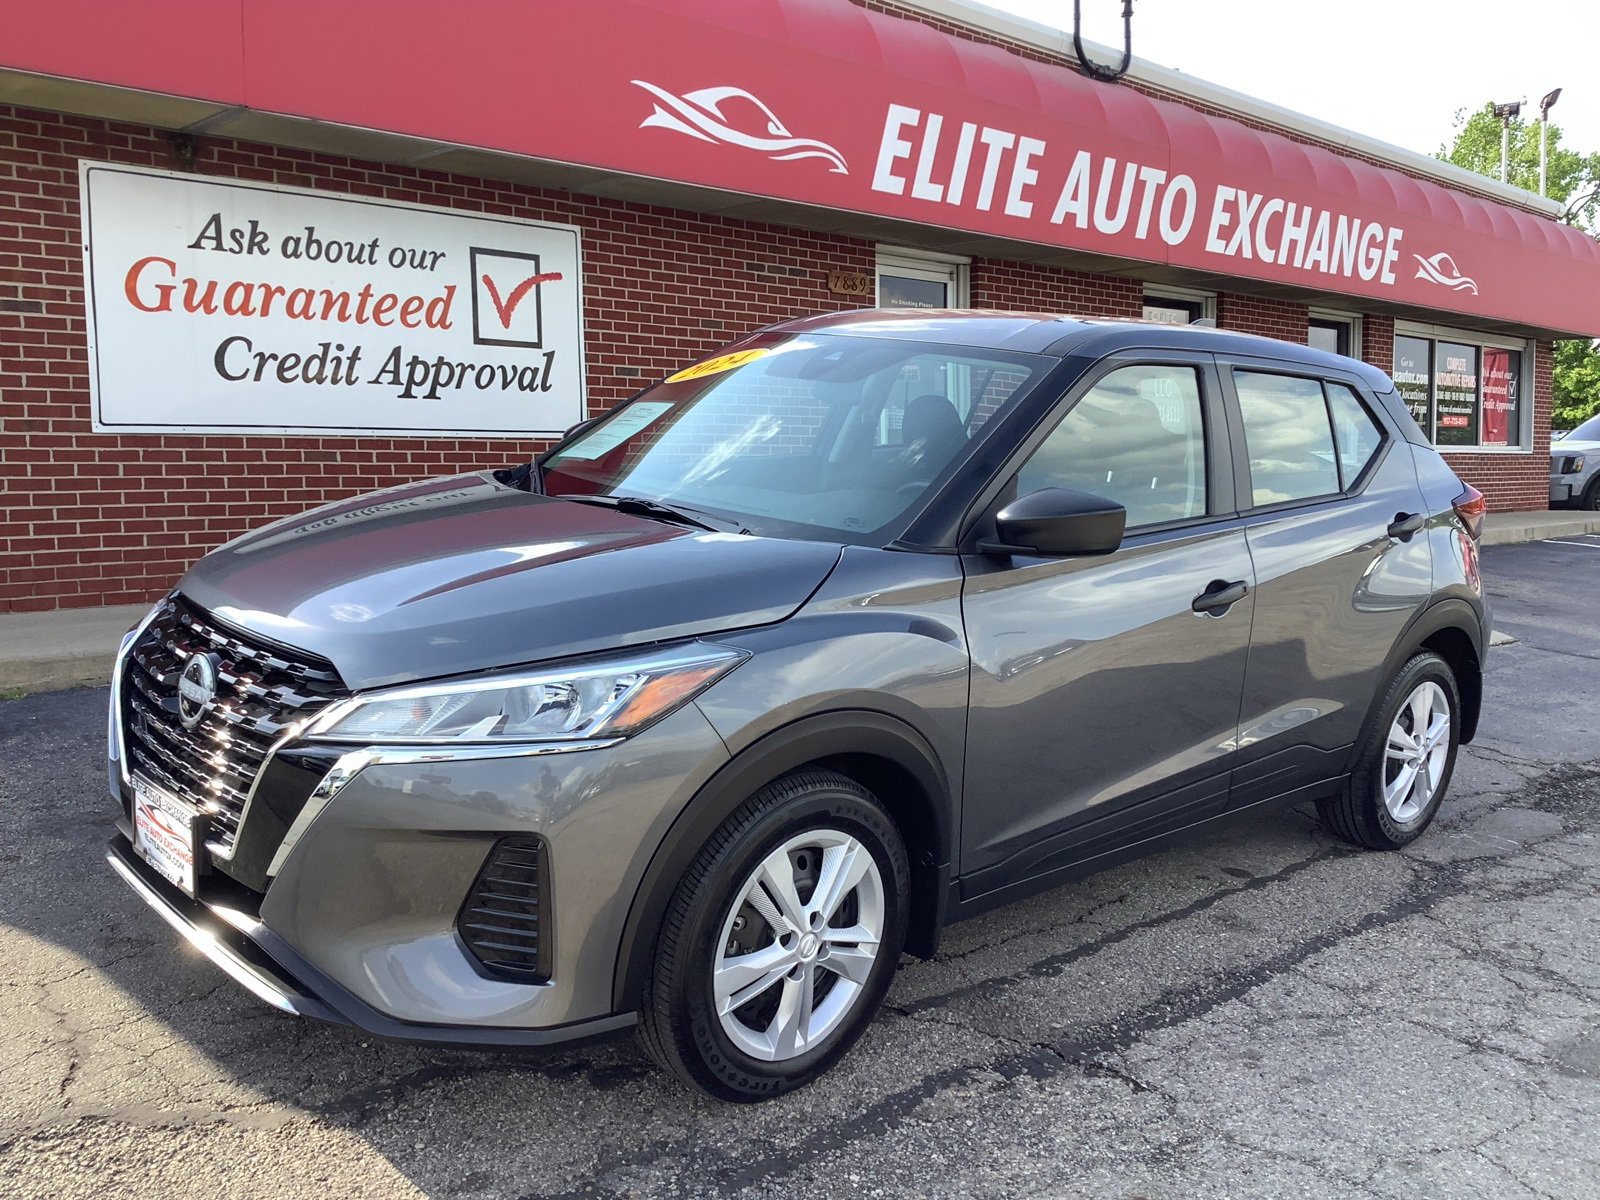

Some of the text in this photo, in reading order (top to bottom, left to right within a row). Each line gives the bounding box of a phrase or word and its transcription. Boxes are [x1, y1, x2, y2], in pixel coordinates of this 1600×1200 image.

[871, 103, 1404, 285] ELITE AUTO EXCHANGE
[188, 213, 446, 272] Ask about our
[124, 256, 457, 330] Guaranteed
[833, 275, 867, 293] 7889
[899, 299, 918, 308] Smoking
[214, 336, 556, 400] Credit Approval
[1490, 368, 1504, 378] about
[1504, 372, 1513, 380] our
[1402, 388, 1428, 400] locations
[1412, 402, 1428, 416] from
[1495, 400, 1516, 413] Approval
[136, 815, 195, 866] ELITE AUTO EXCHANGE
